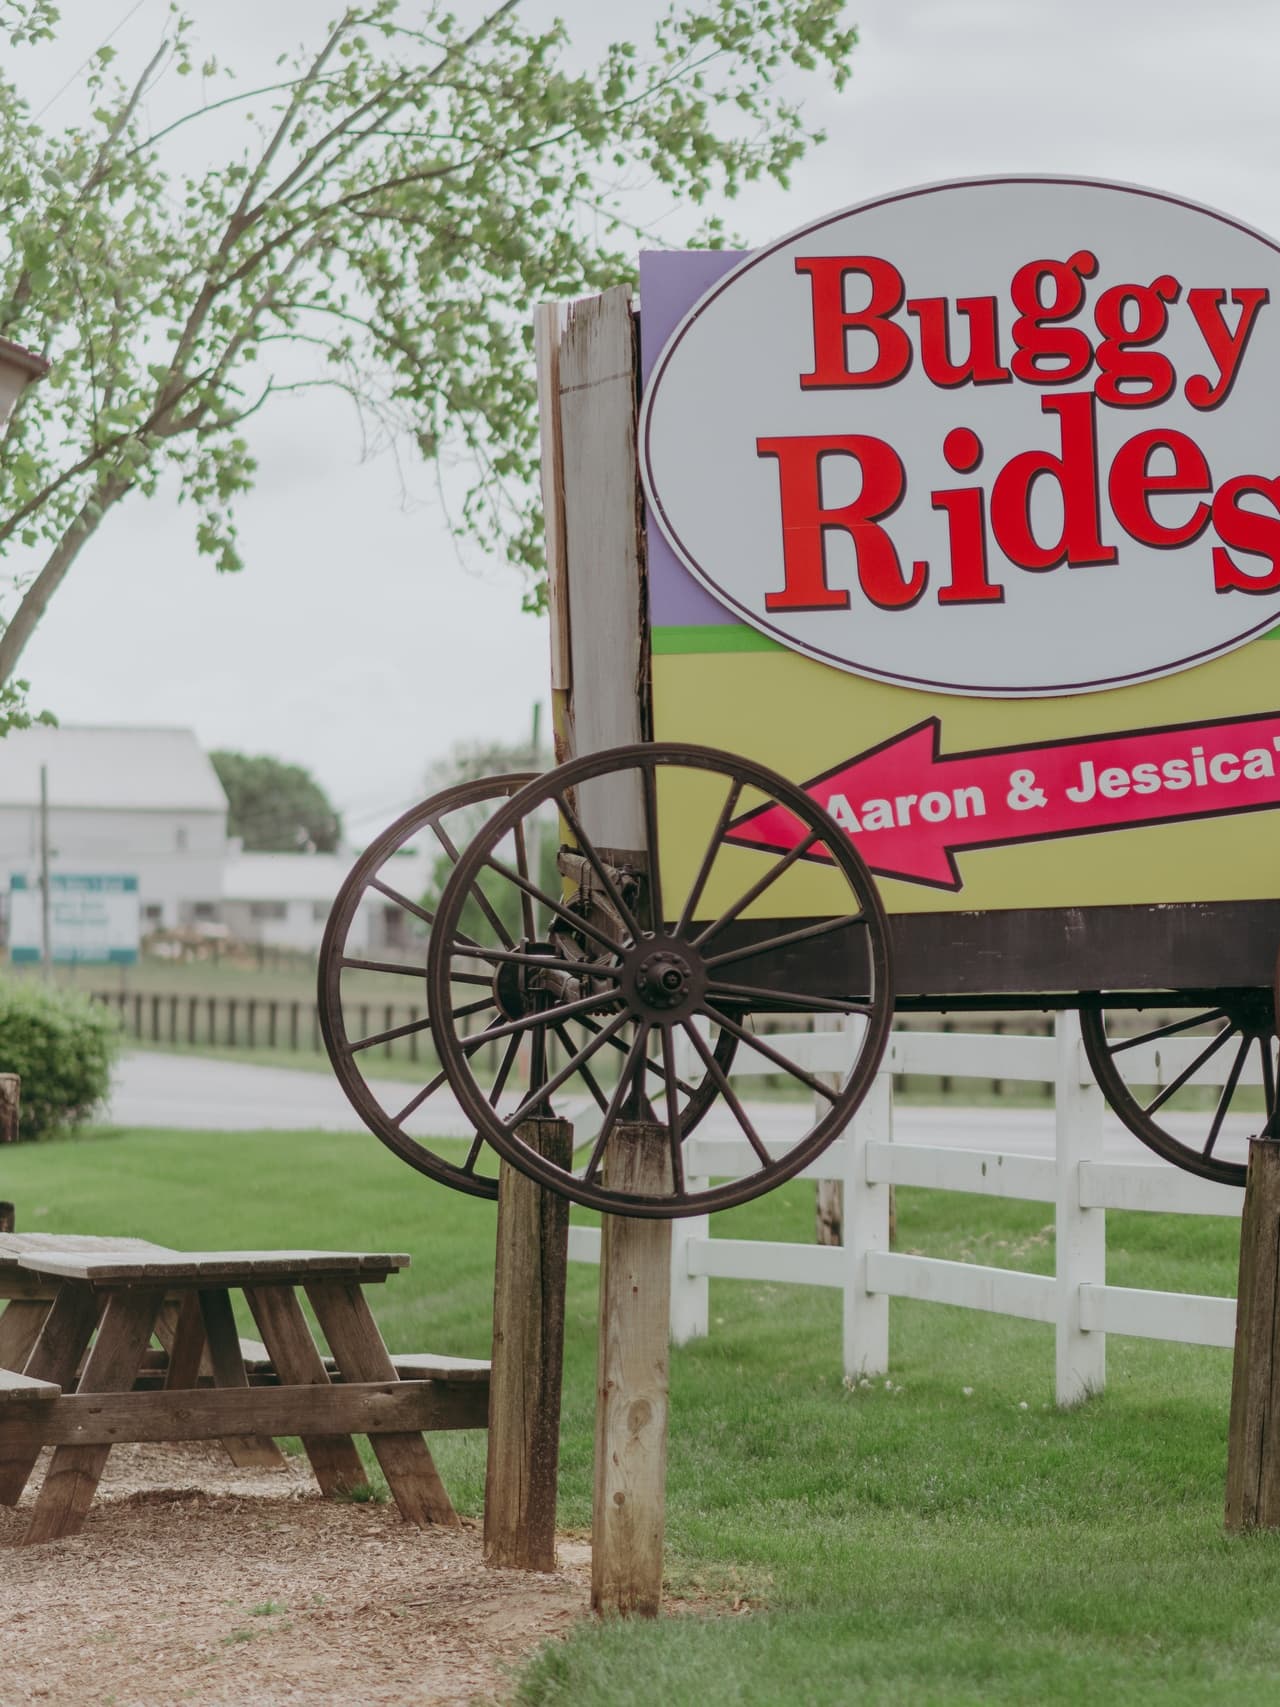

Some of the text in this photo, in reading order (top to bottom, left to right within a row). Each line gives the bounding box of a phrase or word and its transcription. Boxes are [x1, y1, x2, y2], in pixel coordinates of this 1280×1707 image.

[794, 250, 1270, 411] Buggy
[826, 785, 986, 835] Aaron
[1005, 769, 1048, 811] &
